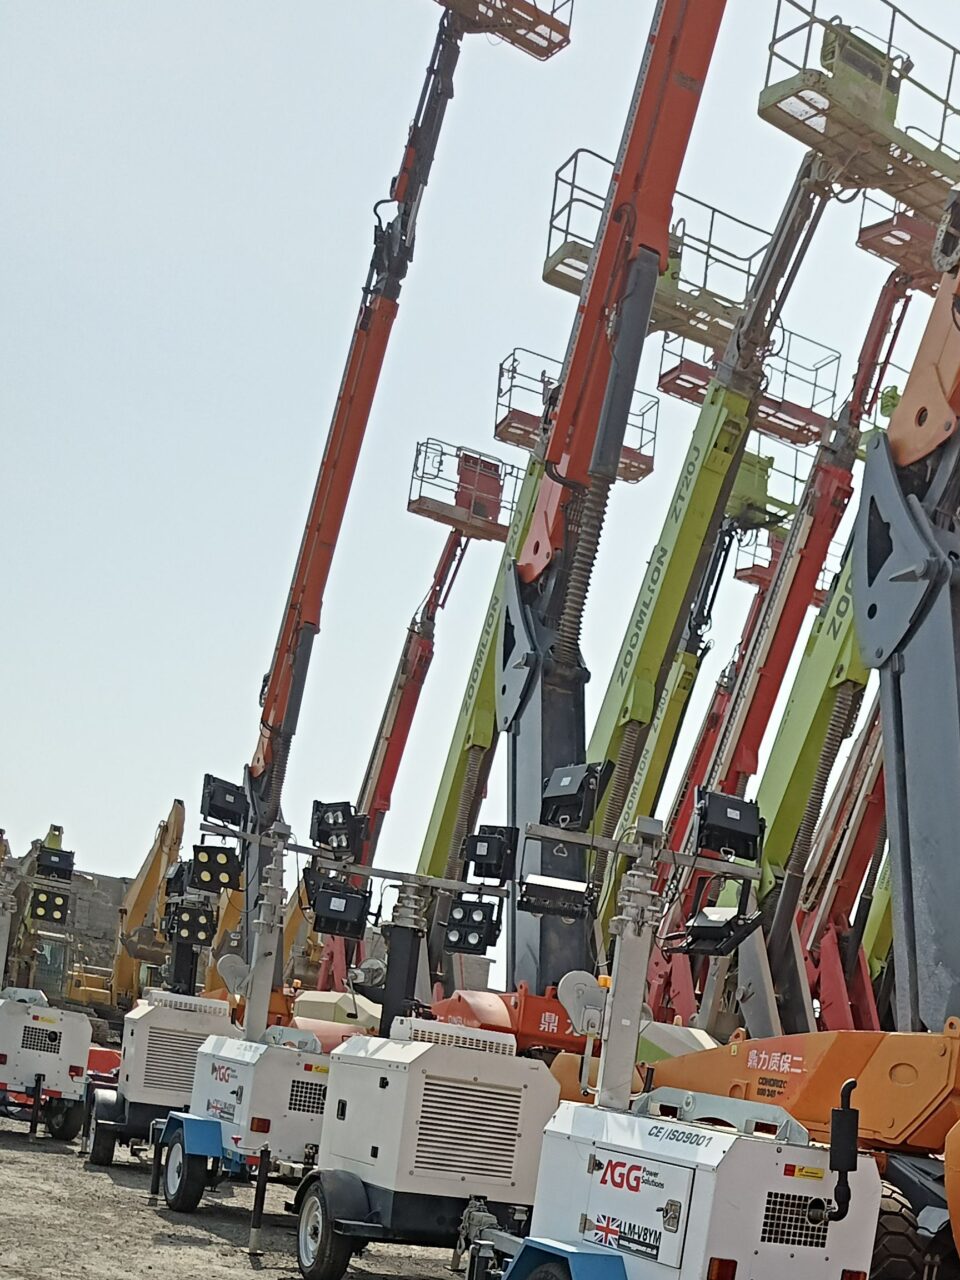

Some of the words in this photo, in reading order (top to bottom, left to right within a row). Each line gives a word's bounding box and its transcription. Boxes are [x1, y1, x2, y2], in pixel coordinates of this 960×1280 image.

[671, 446, 700, 523] ZT20J
[463, 596, 499, 716] ZOOMLION
[619, 748, 650, 833] ZOOMLION
[600, 1160, 642, 1192] AGG
[642, 1167, 660, 1178] Power
[619, 1220, 662, 1245] LLM-V8YM
